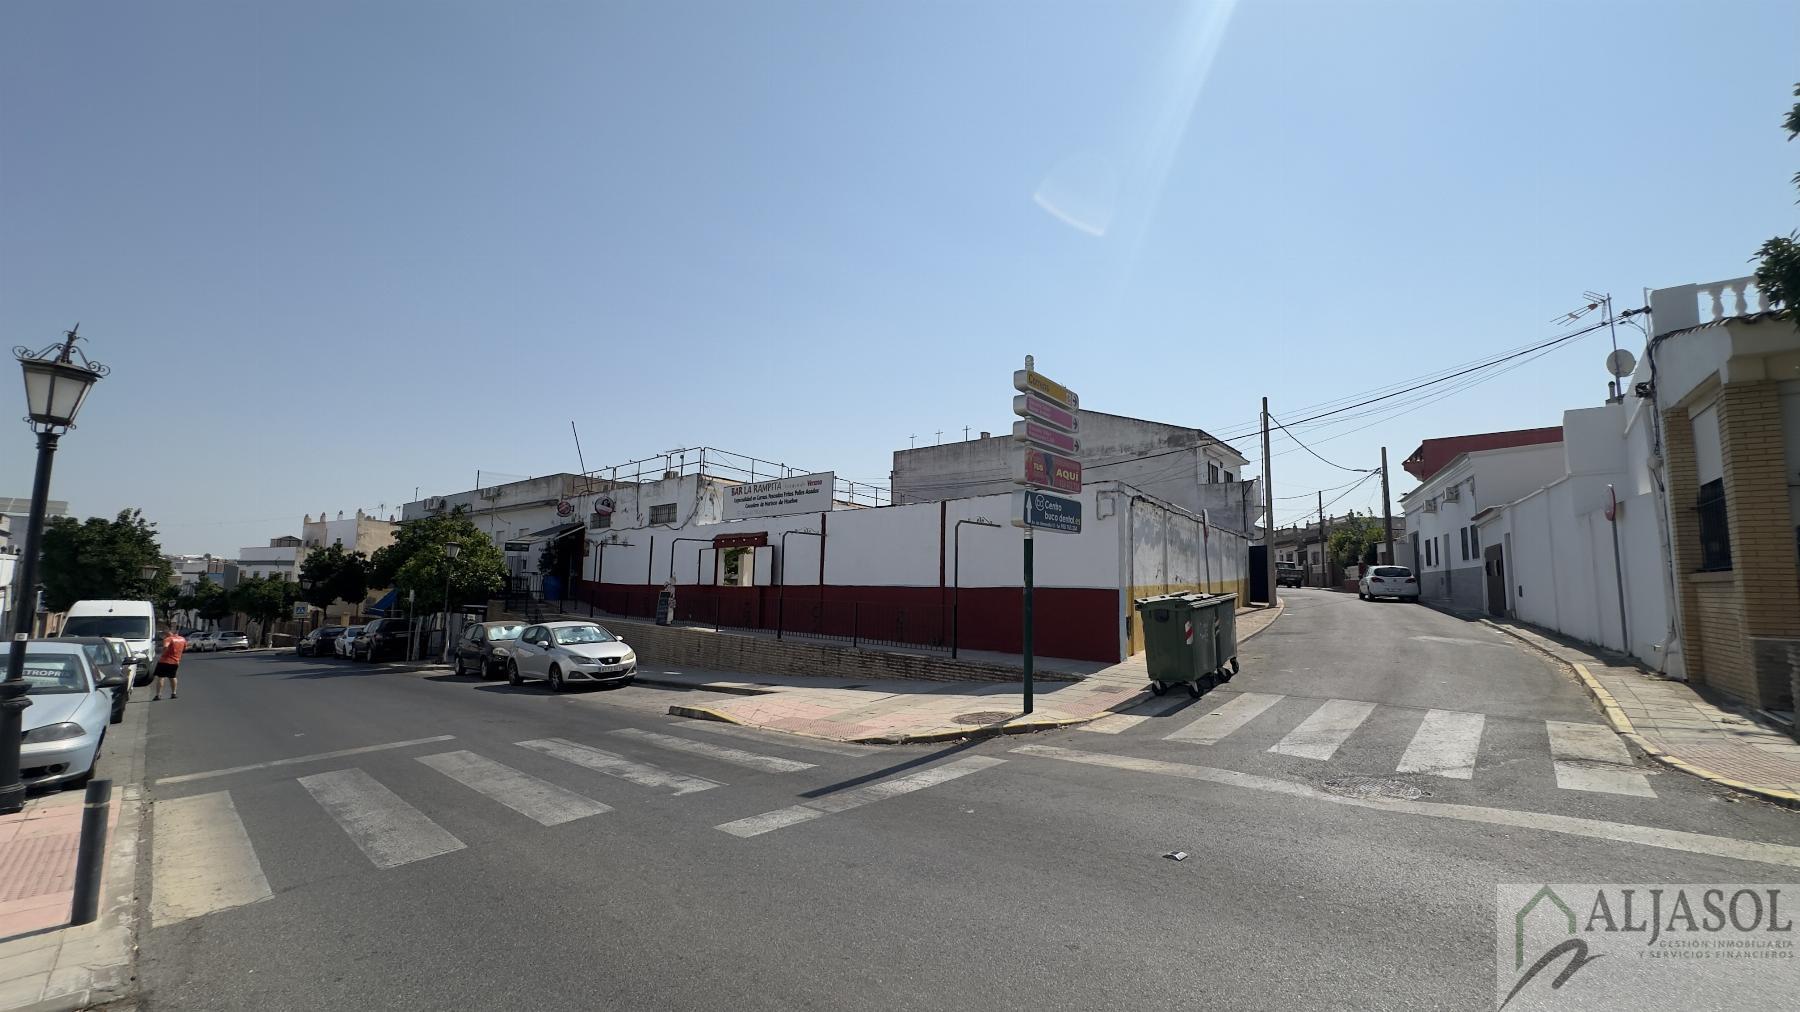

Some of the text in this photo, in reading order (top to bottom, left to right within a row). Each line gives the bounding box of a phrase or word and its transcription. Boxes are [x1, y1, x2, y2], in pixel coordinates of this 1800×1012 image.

[731, 486, 743, 496] BAR
[743, 486, 752, 495] LA
[753, 481, 782, 494] RAMPITA
[1044, 500, 1063, 512] Centro
